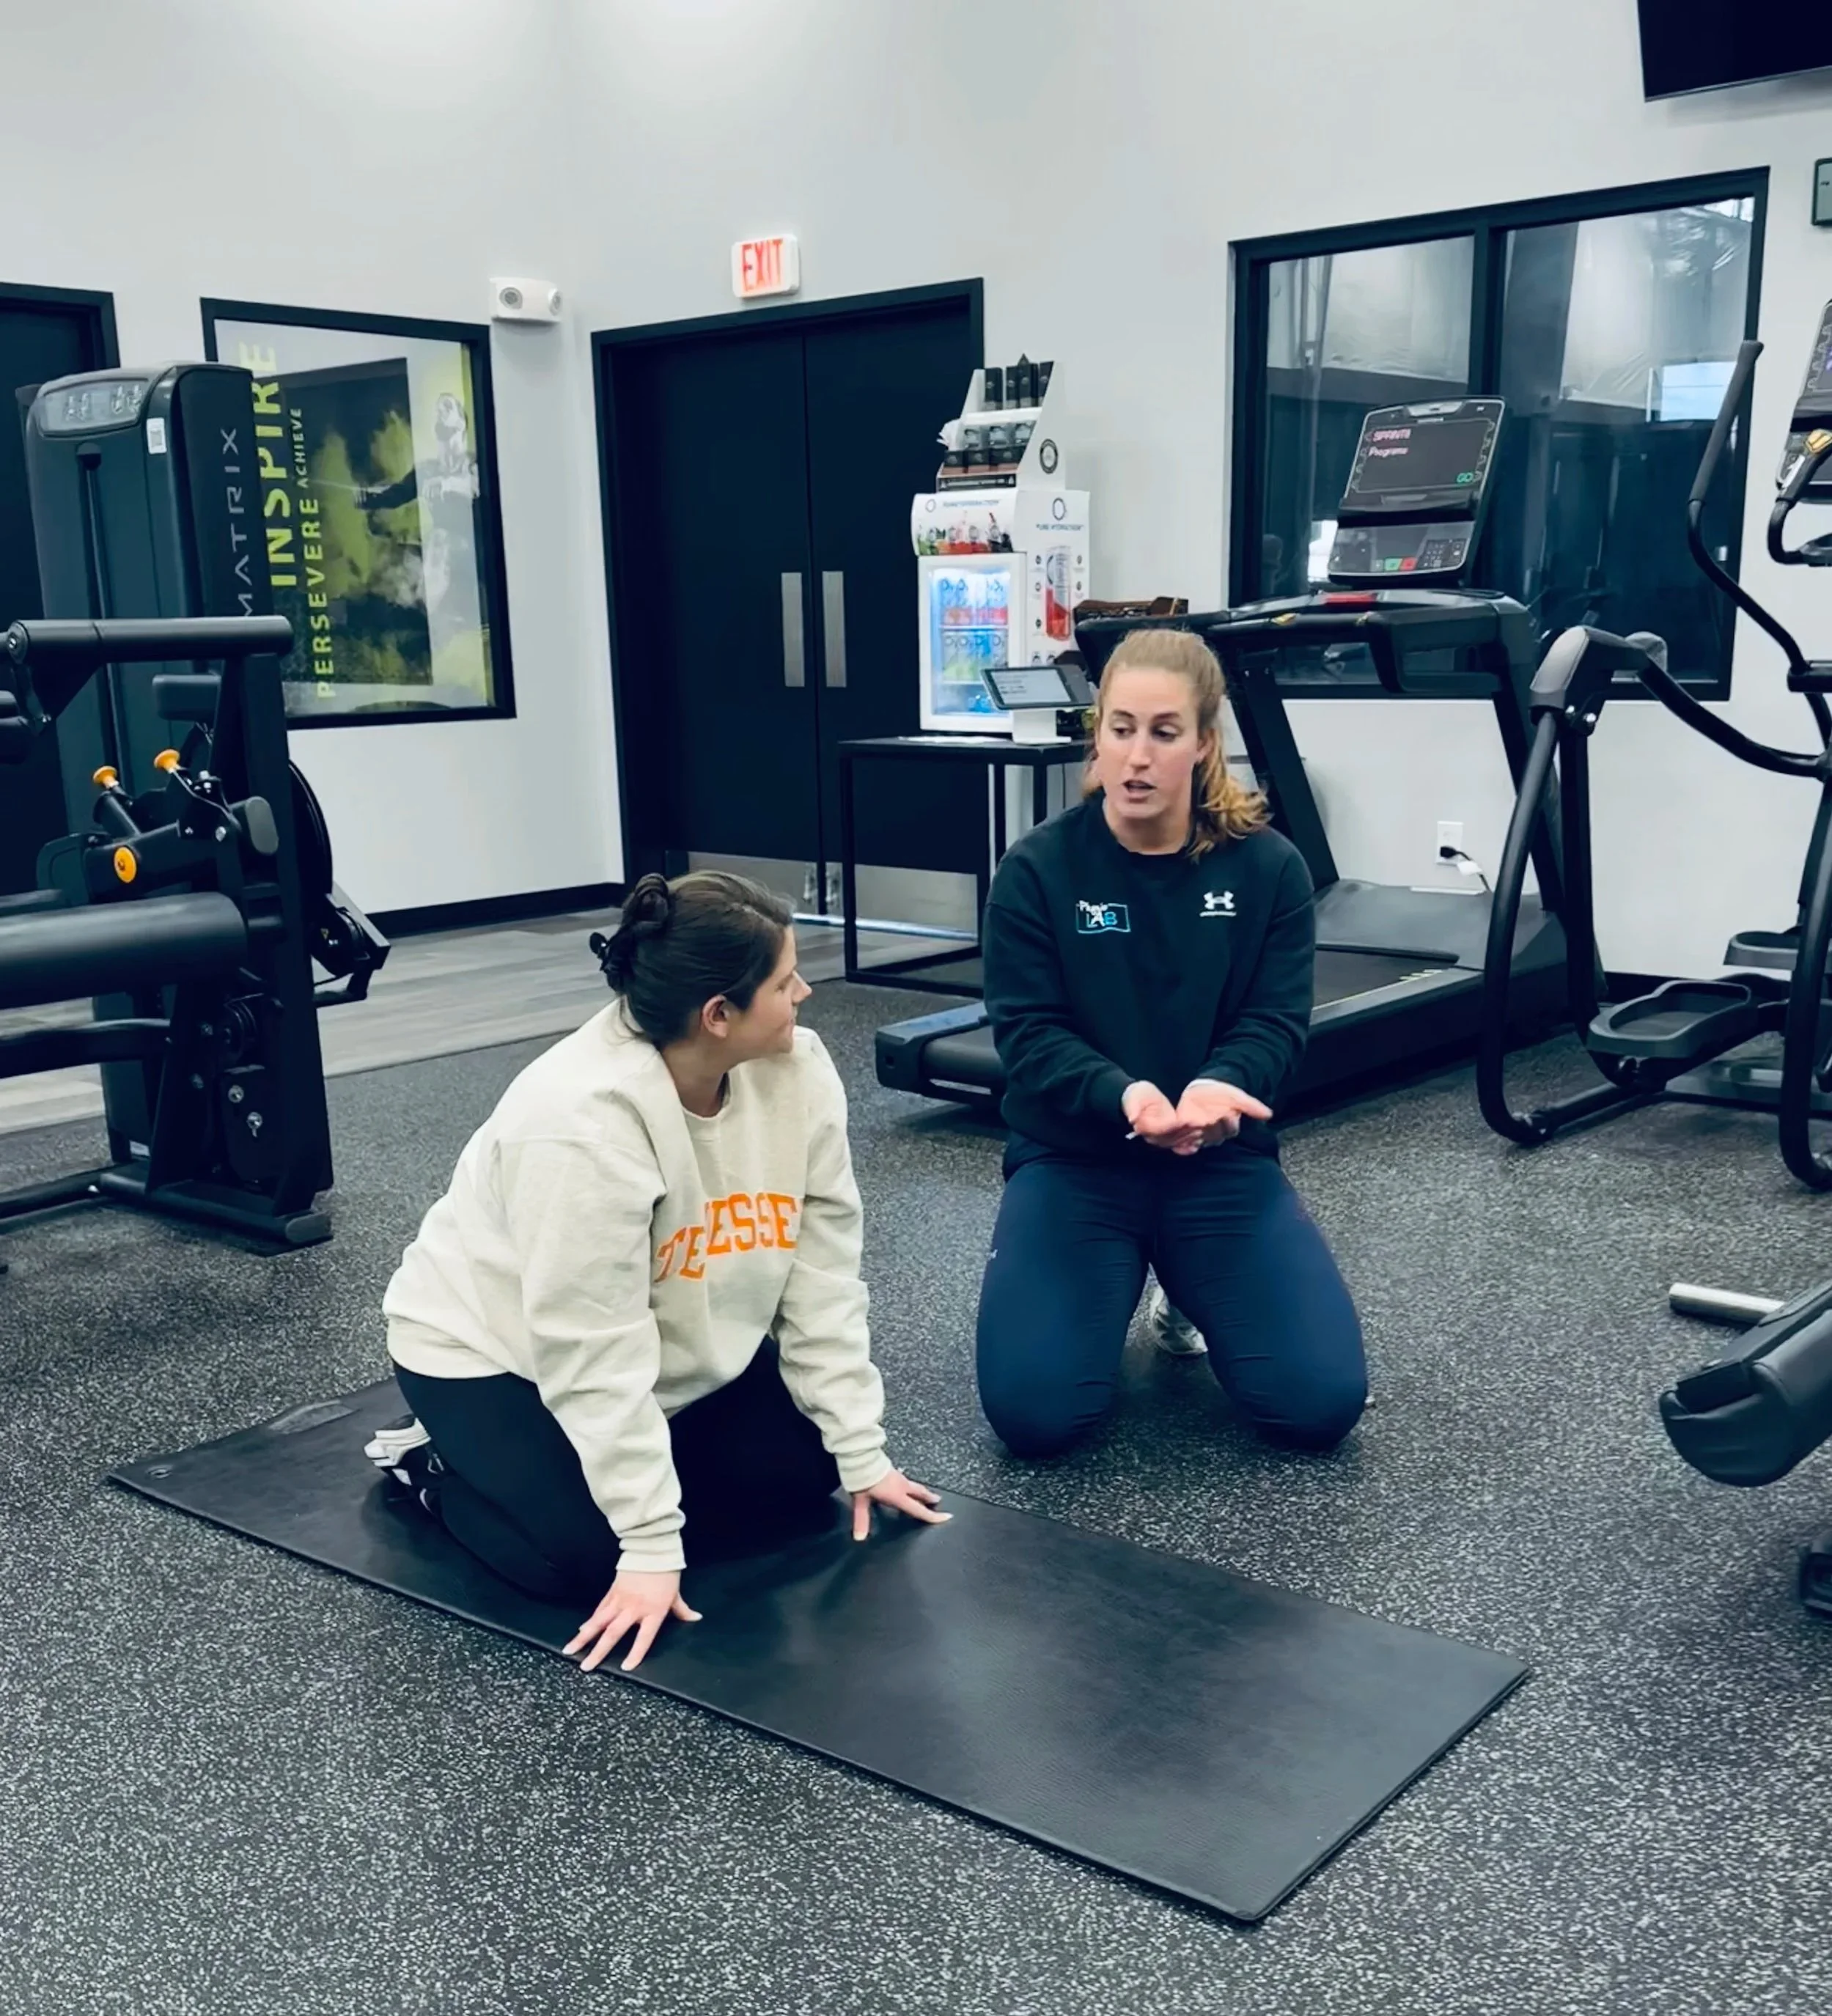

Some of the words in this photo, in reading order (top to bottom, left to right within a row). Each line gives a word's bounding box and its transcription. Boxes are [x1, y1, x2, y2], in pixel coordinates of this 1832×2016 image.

[741, 239, 783, 293] EXIT
[239, 341, 297, 586] INSPIRE
[290, 408, 309, 489] ACHIEVE
[299, 499, 336, 699] PERSEVERE
